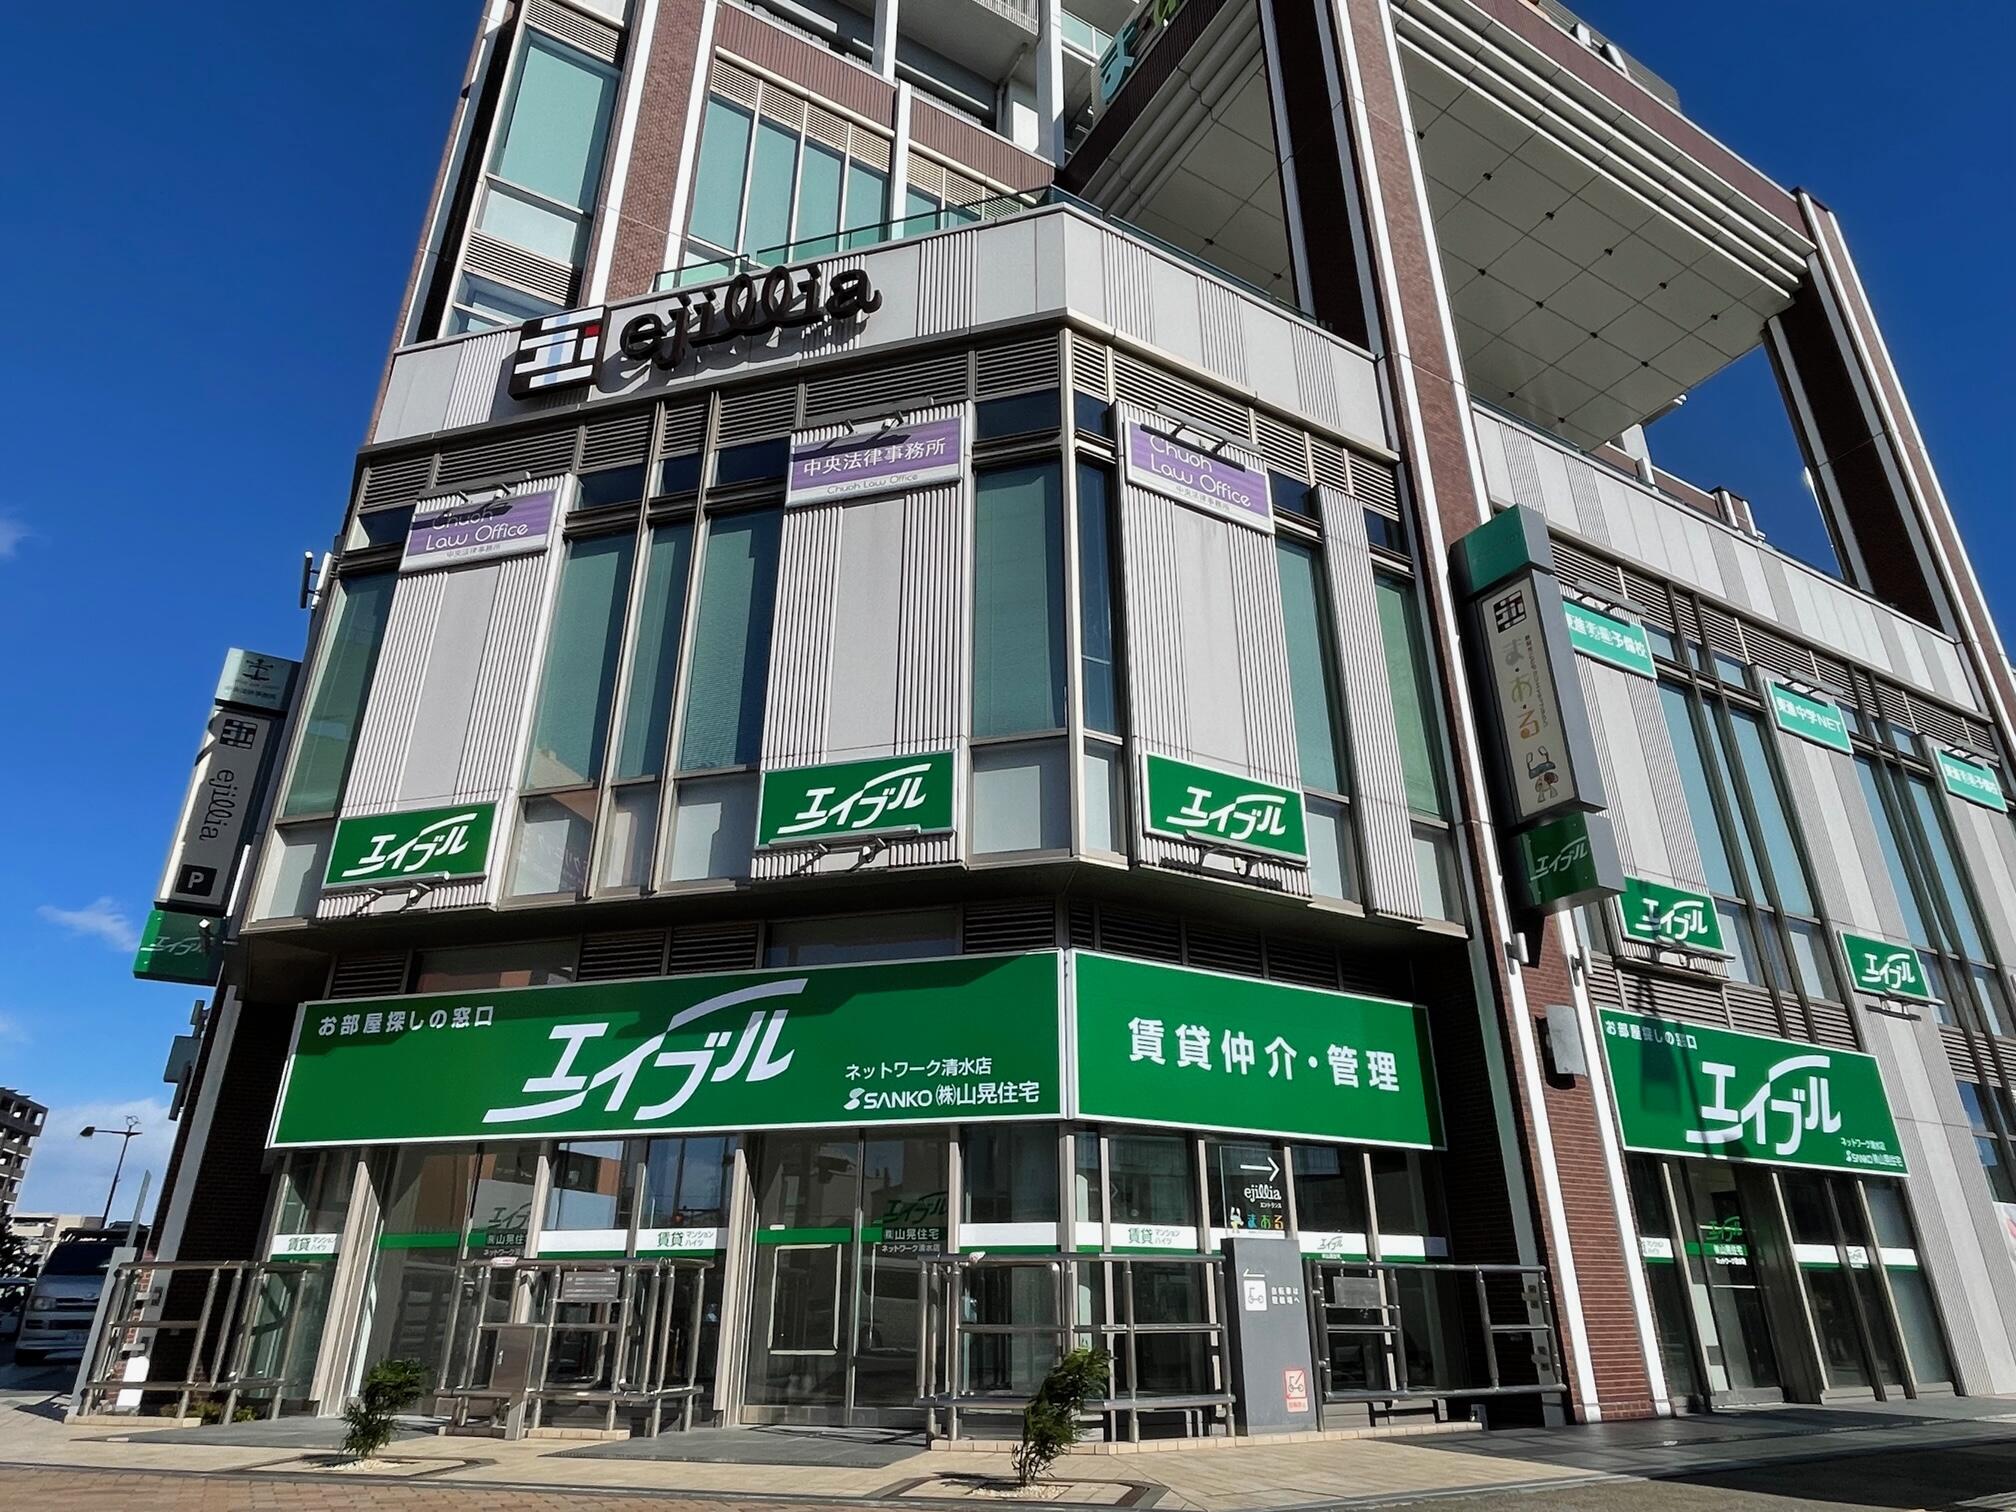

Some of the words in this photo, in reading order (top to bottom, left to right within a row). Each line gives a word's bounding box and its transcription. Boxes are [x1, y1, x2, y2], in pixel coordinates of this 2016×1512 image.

[619, 264, 882, 370] ejillia
[803, 437, 946, 477] 中央法律事務所
[1149, 434, 1213, 473] Chuoh
[826, 483, 861, 495] Chuoh
[863, 478, 887, 489] Law
[889, 472, 918, 484] Office
[1150, 453, 1193, 484] Law
[1199, 474, 1251, 507] Office
[431, 506, 494, 530] Chuoh
[426, 533, 468, 551] Law
[474, 523, 528, 542] Office
[199, 768, 236, 841] ejillia
[776, 762, 932, 834] エイブル
[1165, 786, 1287, 840] エイブル
[341, 812, 478, 877] エイブル
[1530, 836, 1588, 881] エイブル
[187, 870, 205, 889] P
[1635, 897, 1709, 941] エイブル
[1861, 953, 1916, 989] エイブル
[318, 1005, 494, 1037] お部屋探しの窓口
[1604, 1020, 1698, 1050] お部屋探しの窓口
[481, 977, 808, 1124] エイブル
[1127, 1016, 1401, 1092] 賃貸仲介・管理
[845, 1056, 992, 1081] ネットワーク清水店
[864, 1089, 932, 1109] SANKO
[1686, 1055, 1842, 1156] エイブル
[1243, 1183, 1282, 1203] ejillia
[287, 1237, 311, 1251] 賃貸
[657, 1231, 684, 1247] 賃貸
[685, 1230, 714, 1239] マンション
[881, 1243, 941, 1253] ネットワーク清水店
[1127, 1227, 1153, 1244] 賃貸
